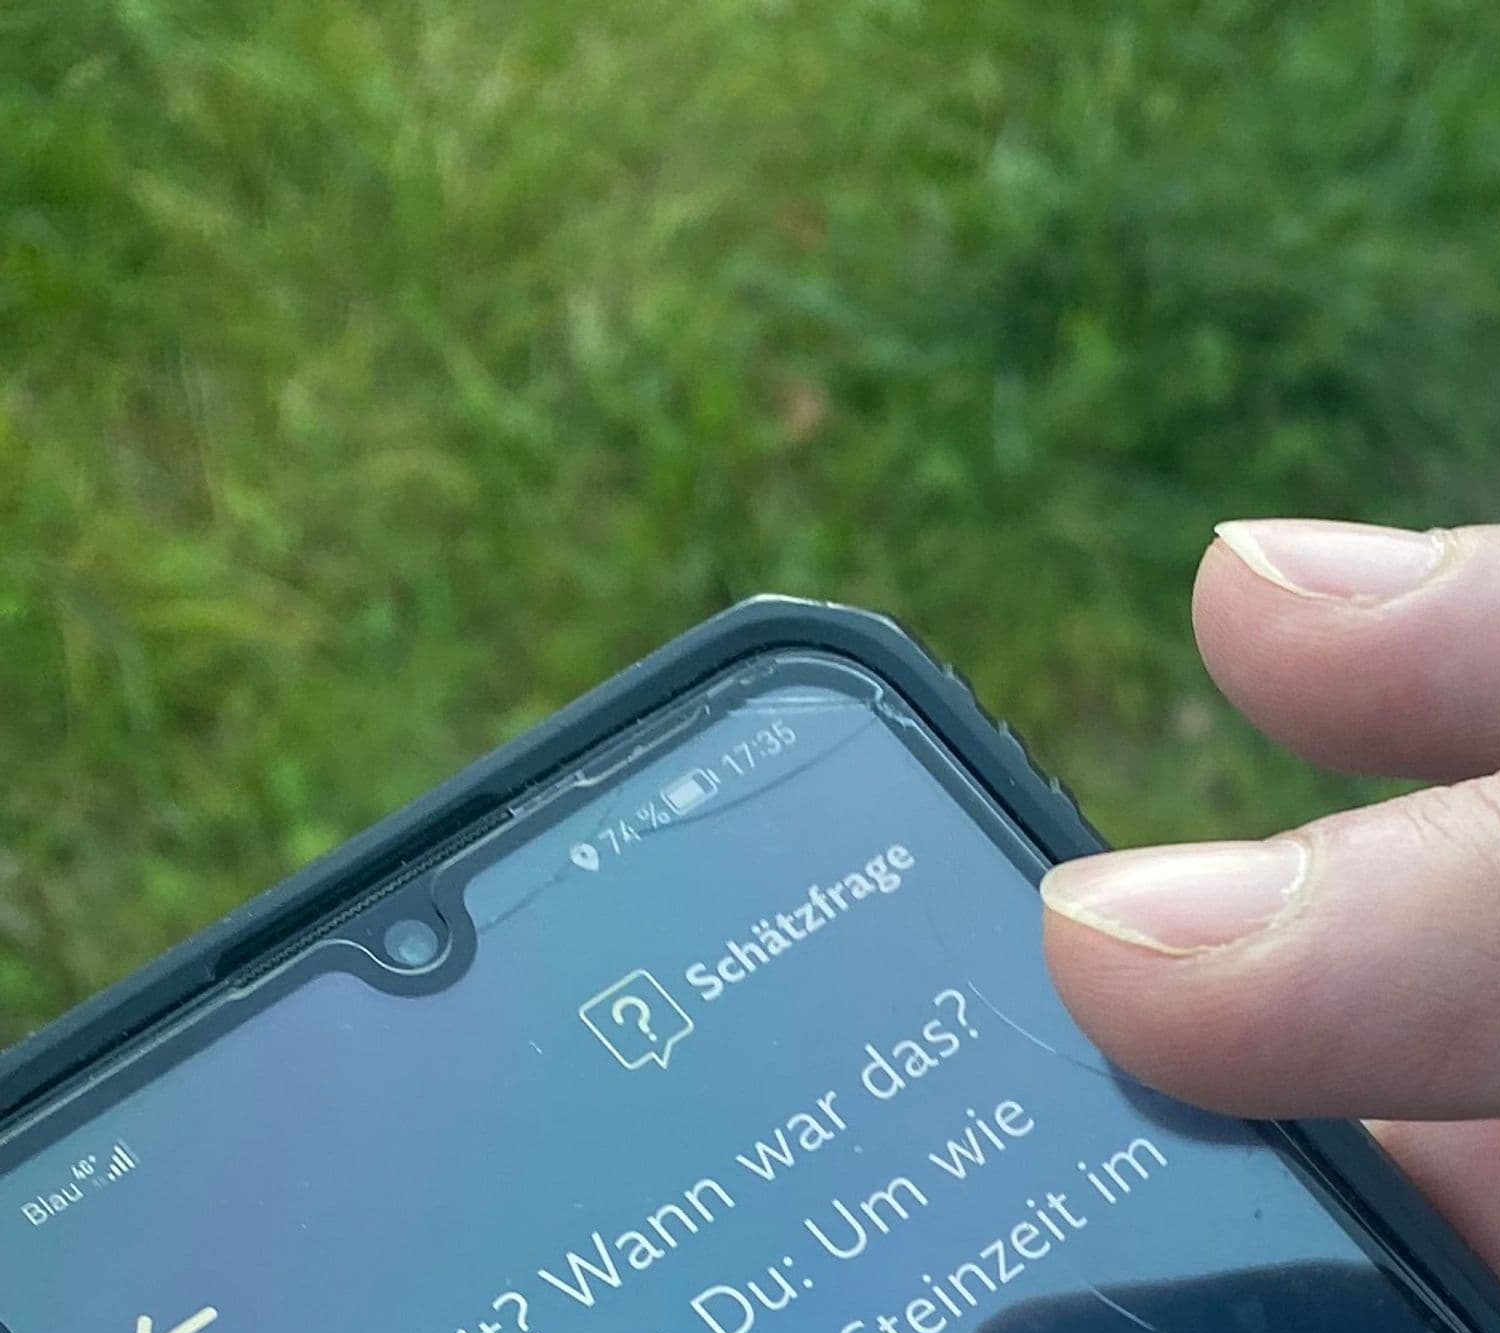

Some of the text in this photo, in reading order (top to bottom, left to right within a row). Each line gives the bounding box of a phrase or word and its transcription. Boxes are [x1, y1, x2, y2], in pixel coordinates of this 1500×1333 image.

[721, 719, 797, 778] 17:35
[685, 844, 914, 1000] Schätzfrage
[20, 1182, 84, 1226] Blau
[537, 1178, 735, 1308] Wann
[736, 1090, 847, 1182] war
[861, 989, 979, 1100] das?
[803, 1174, 928, 1259] Um
[929, 1099, 1035, 1180] wie
[1077, 1136, 1168, 1205] im
